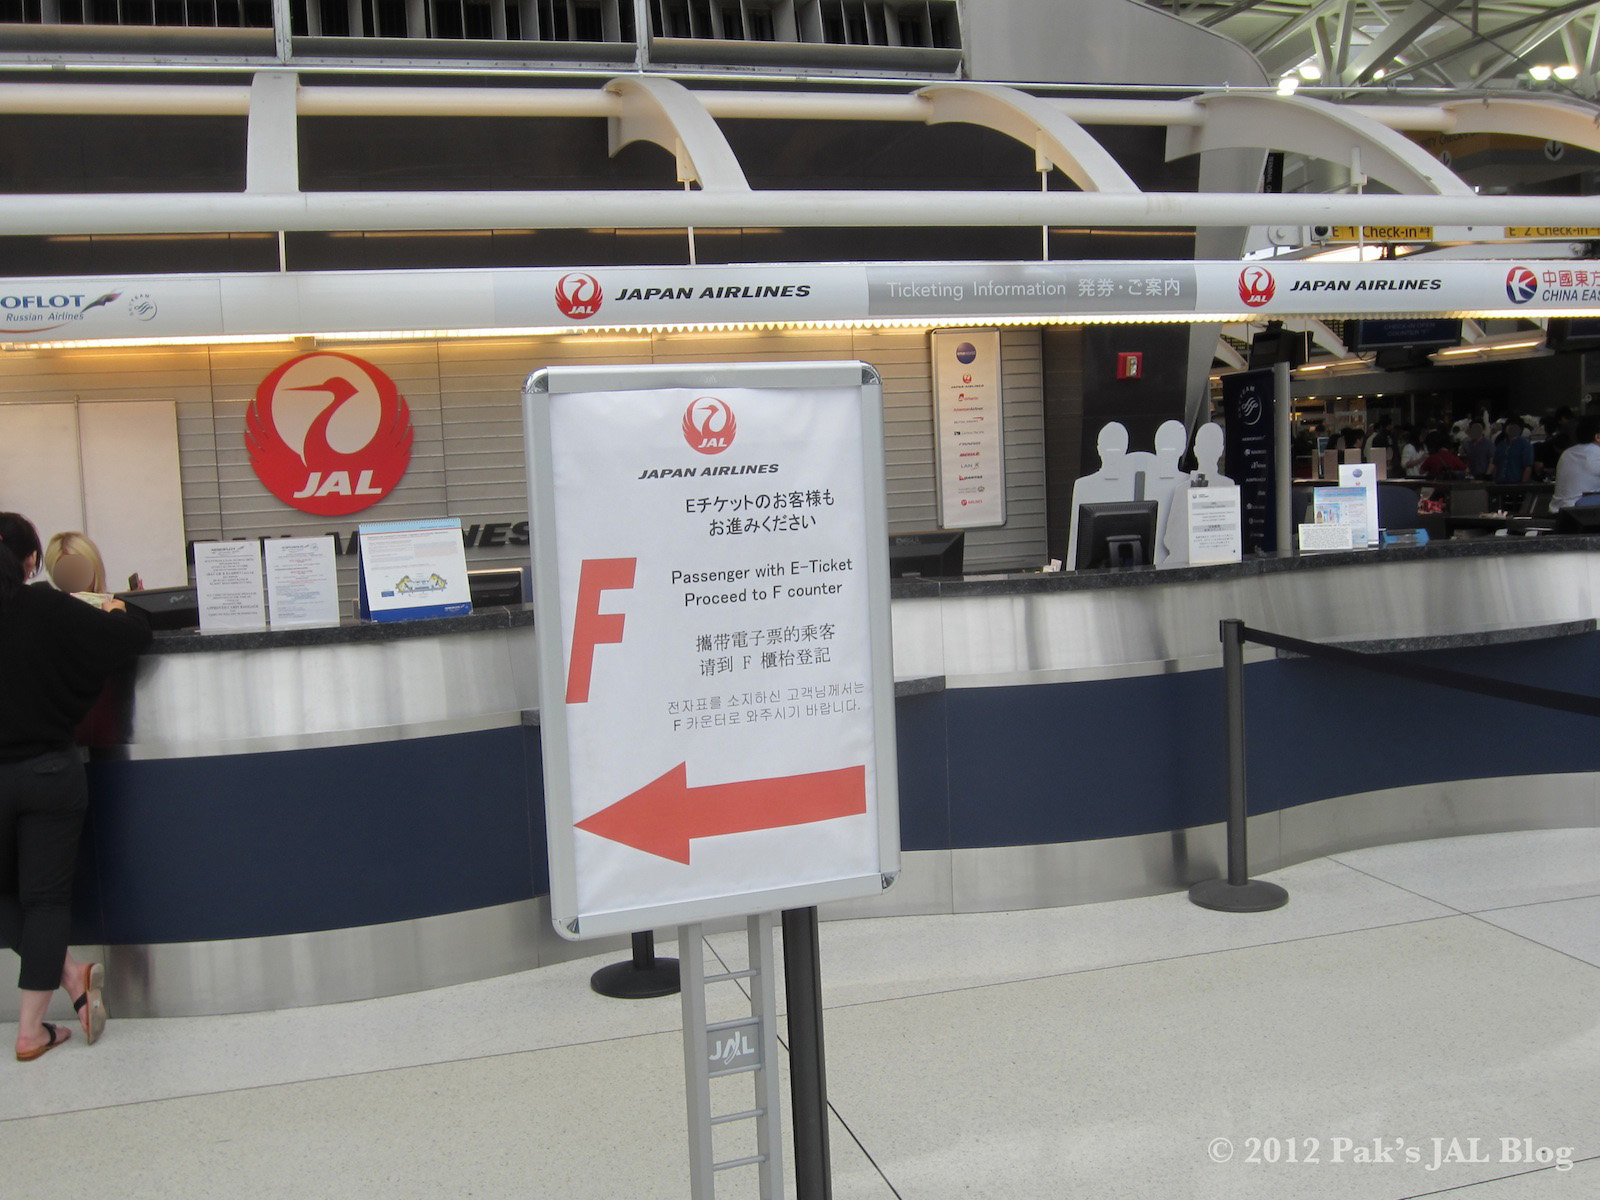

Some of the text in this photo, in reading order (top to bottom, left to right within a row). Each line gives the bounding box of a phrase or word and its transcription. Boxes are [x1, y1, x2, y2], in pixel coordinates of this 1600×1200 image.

[1363, 226, 1417, 238] Check-in
[615, 285, 811, 301] JAPAN AIRLINES
[887, 281, 964, 301] Ticketing
[973, 280, 1066, 297] Information
[1290, 279, 1442, 292] JAPAN AIRLINES
[1542, 289, 1578, 302] CHINA
[567, 305, 595, 314] JAL
[1247, 294, 1268, 304] JAL
[6, 311, 84, 322] Russian Airlines
[698, 437, 728, 448] JAL
[638, 464, 779, 480] JAPAN AIRLINES
[293, 470, 382, 498] JAL
[686, 489, 835, 514] Eチケットのお客様も
[709, 514, 816, 537] お進みください
[671, 558, 853, 585] Passenger with E-Ticket
[684, 582, 843, 607] Proceed to F counter
[565, 557, 637, 704] F
[699, 655, 733, 677] 请到
[742, 655, 752, 670] F
[668, 682, 864, 715] 전자표를 소지하신 고객님께서는
[673, 699, 861, 731] F 카운터로 와주시기 바랍니다.
[708, 1031, 755, 1065] JAL
